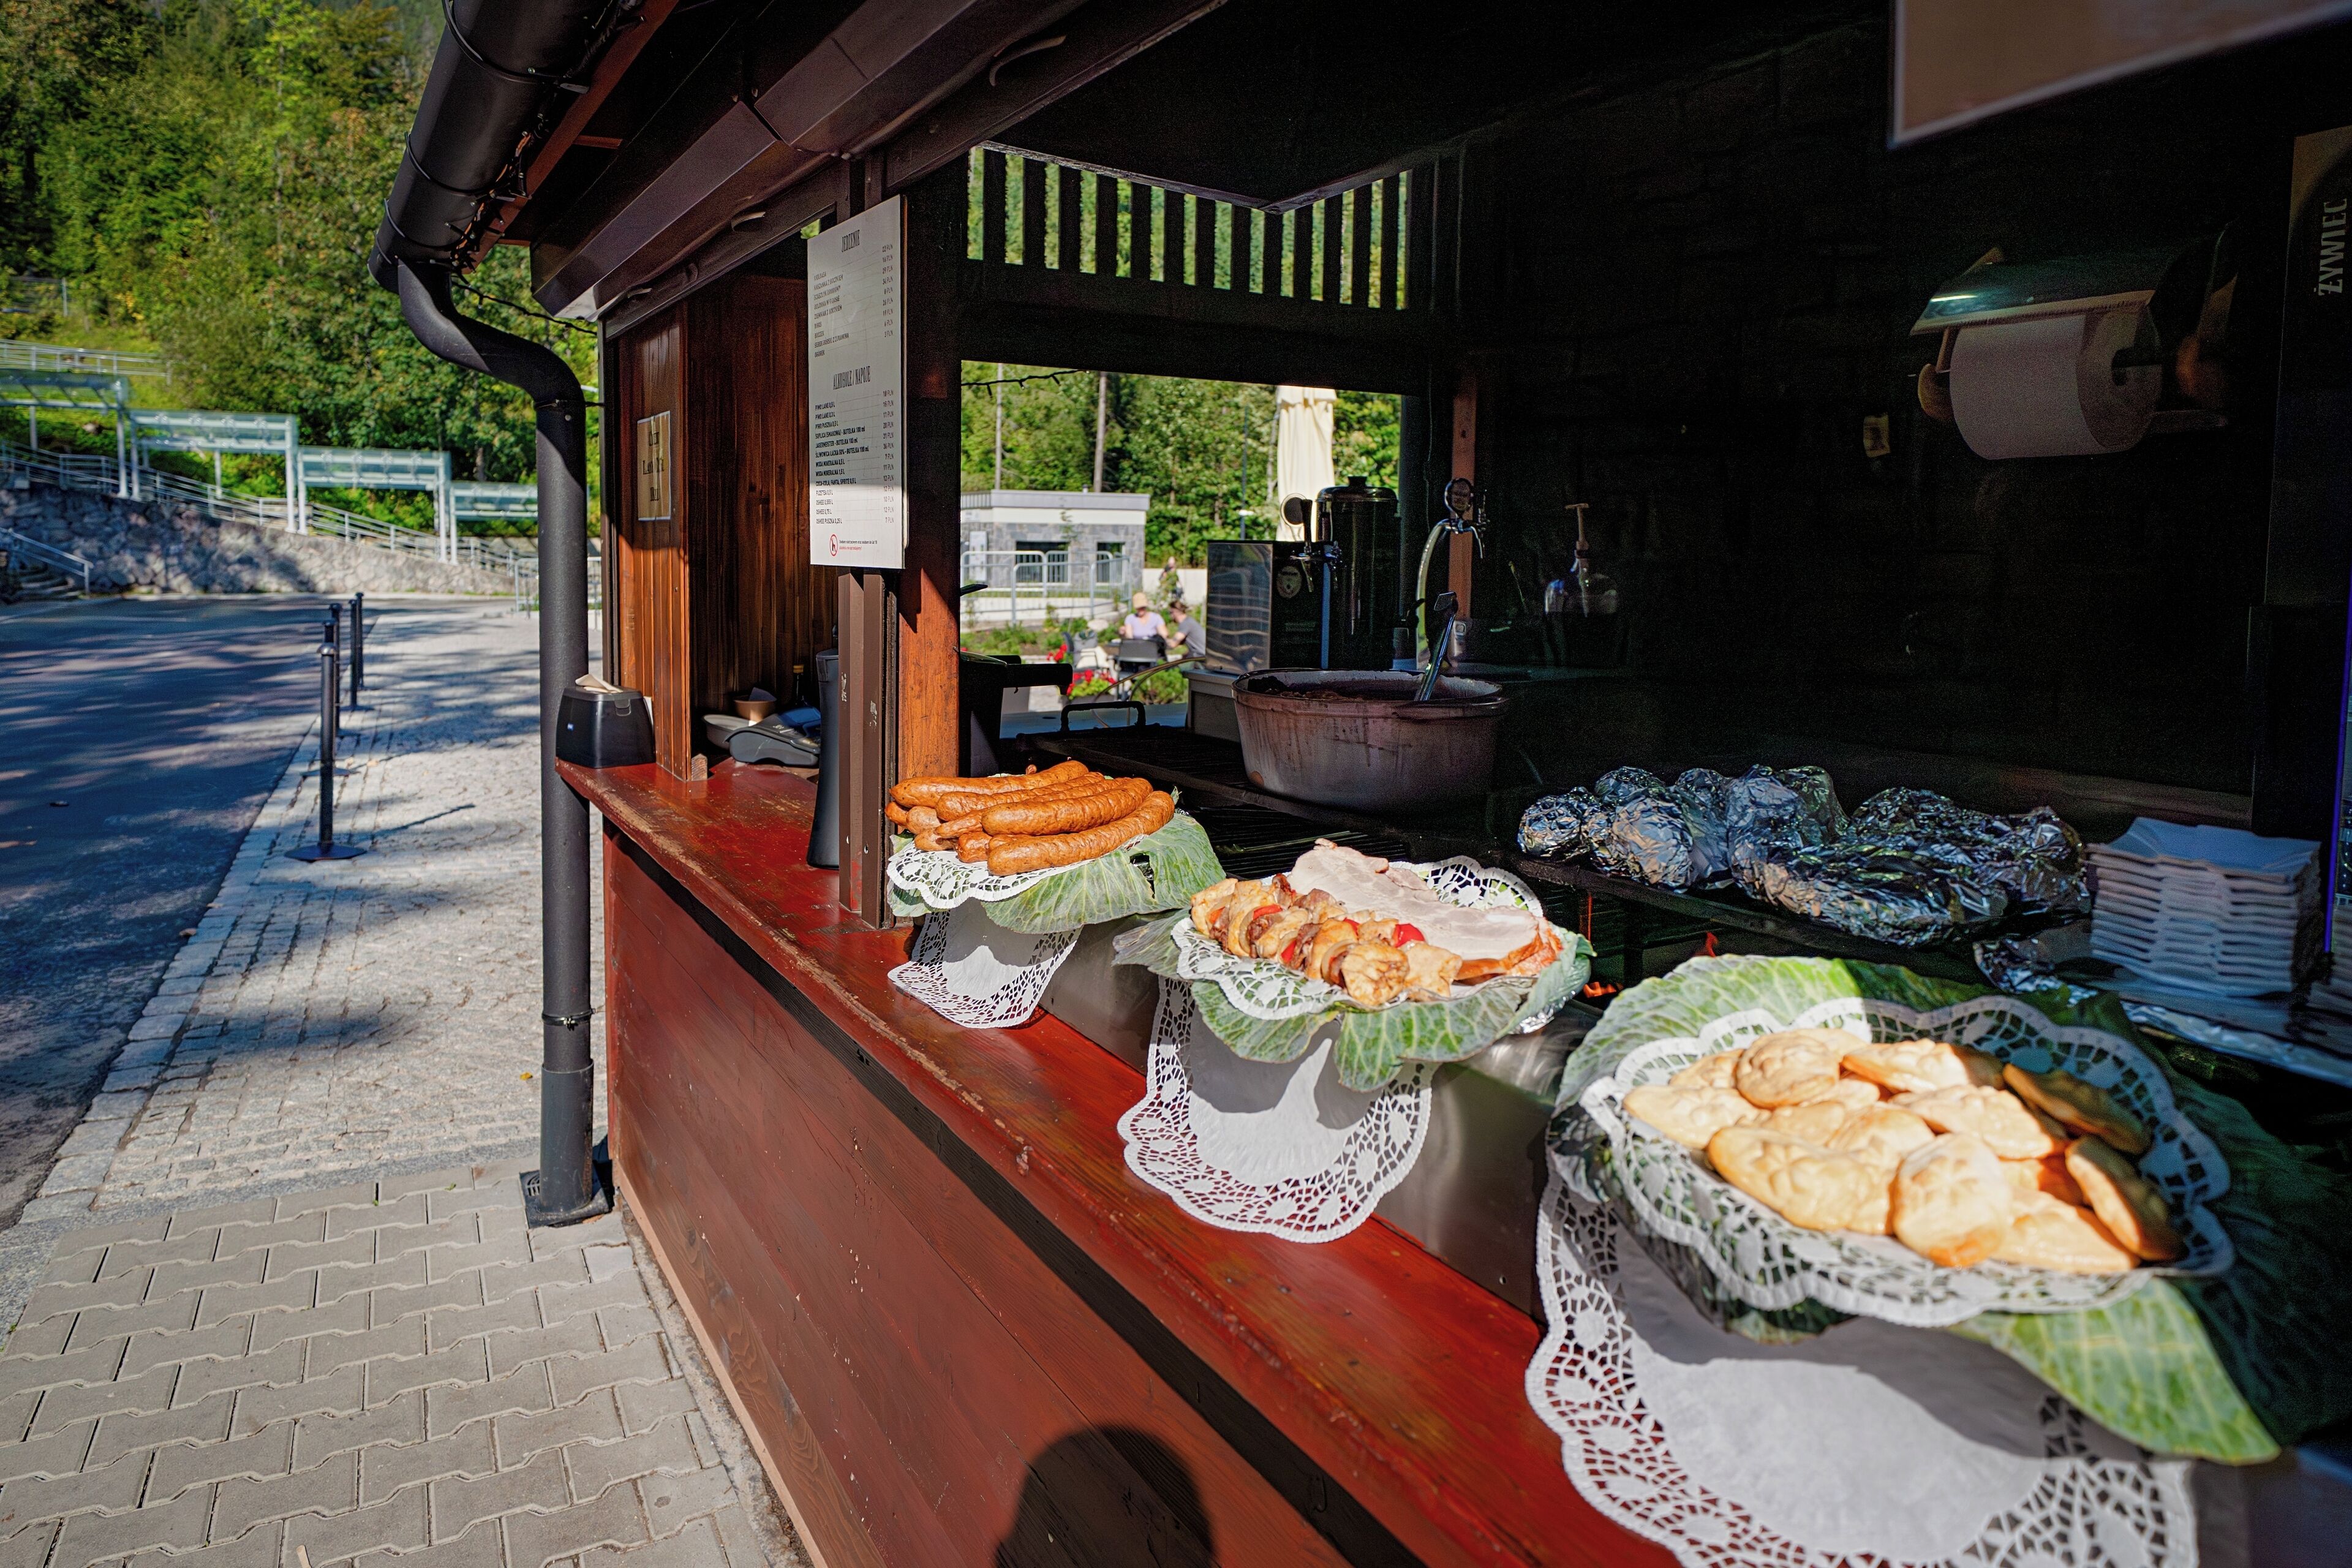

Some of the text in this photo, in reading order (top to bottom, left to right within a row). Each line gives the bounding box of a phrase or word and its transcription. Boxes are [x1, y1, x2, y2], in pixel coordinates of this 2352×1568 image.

[842, 229, 860, 252] JEDZENIE
[2314, 198, 2347, 296] ŻYWIEC
[833, 370, 852, 390] ALKOHOLE
[855, 366, 870, 385] NAPOJE
